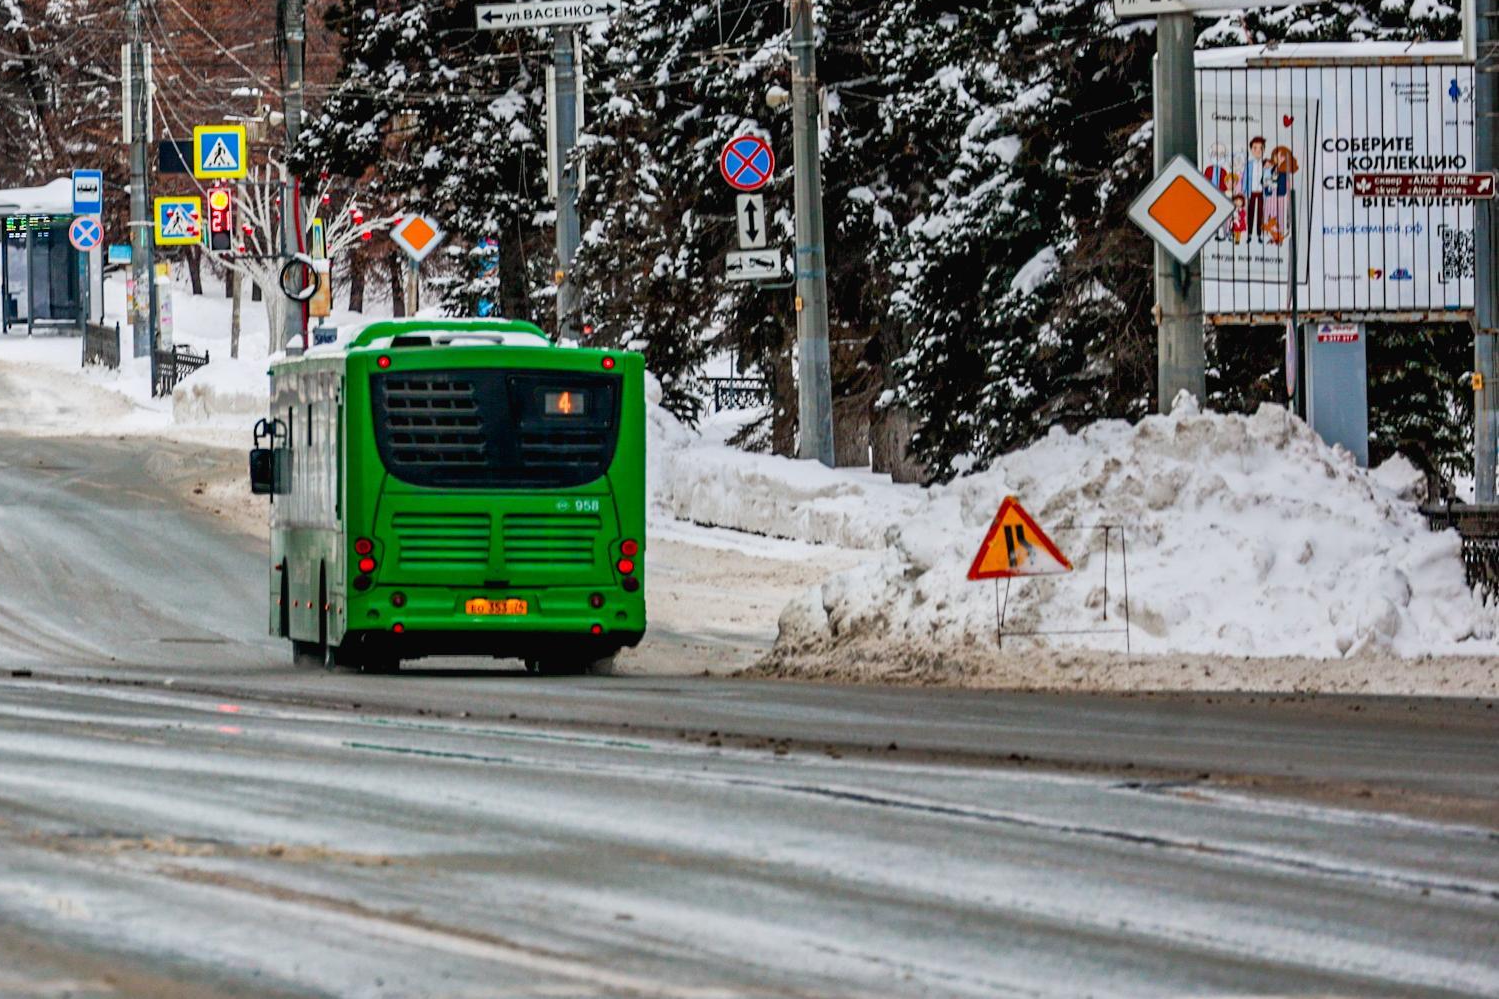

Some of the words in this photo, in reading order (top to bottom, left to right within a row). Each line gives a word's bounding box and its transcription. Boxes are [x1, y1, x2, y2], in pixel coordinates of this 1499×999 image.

[1322, 137, 1414, 152] СОБЕРИТЕ
[1347, 155, 1467, 172] КОЛЛЕКЦИЮ
[1375, 176, 1402, 187] сквер
[1375, 186, 1401, 195] skver
[212, 210, 230, 232] 21
[558, 391, 571, 414] 4
[575, 500, 599, 511] 958
